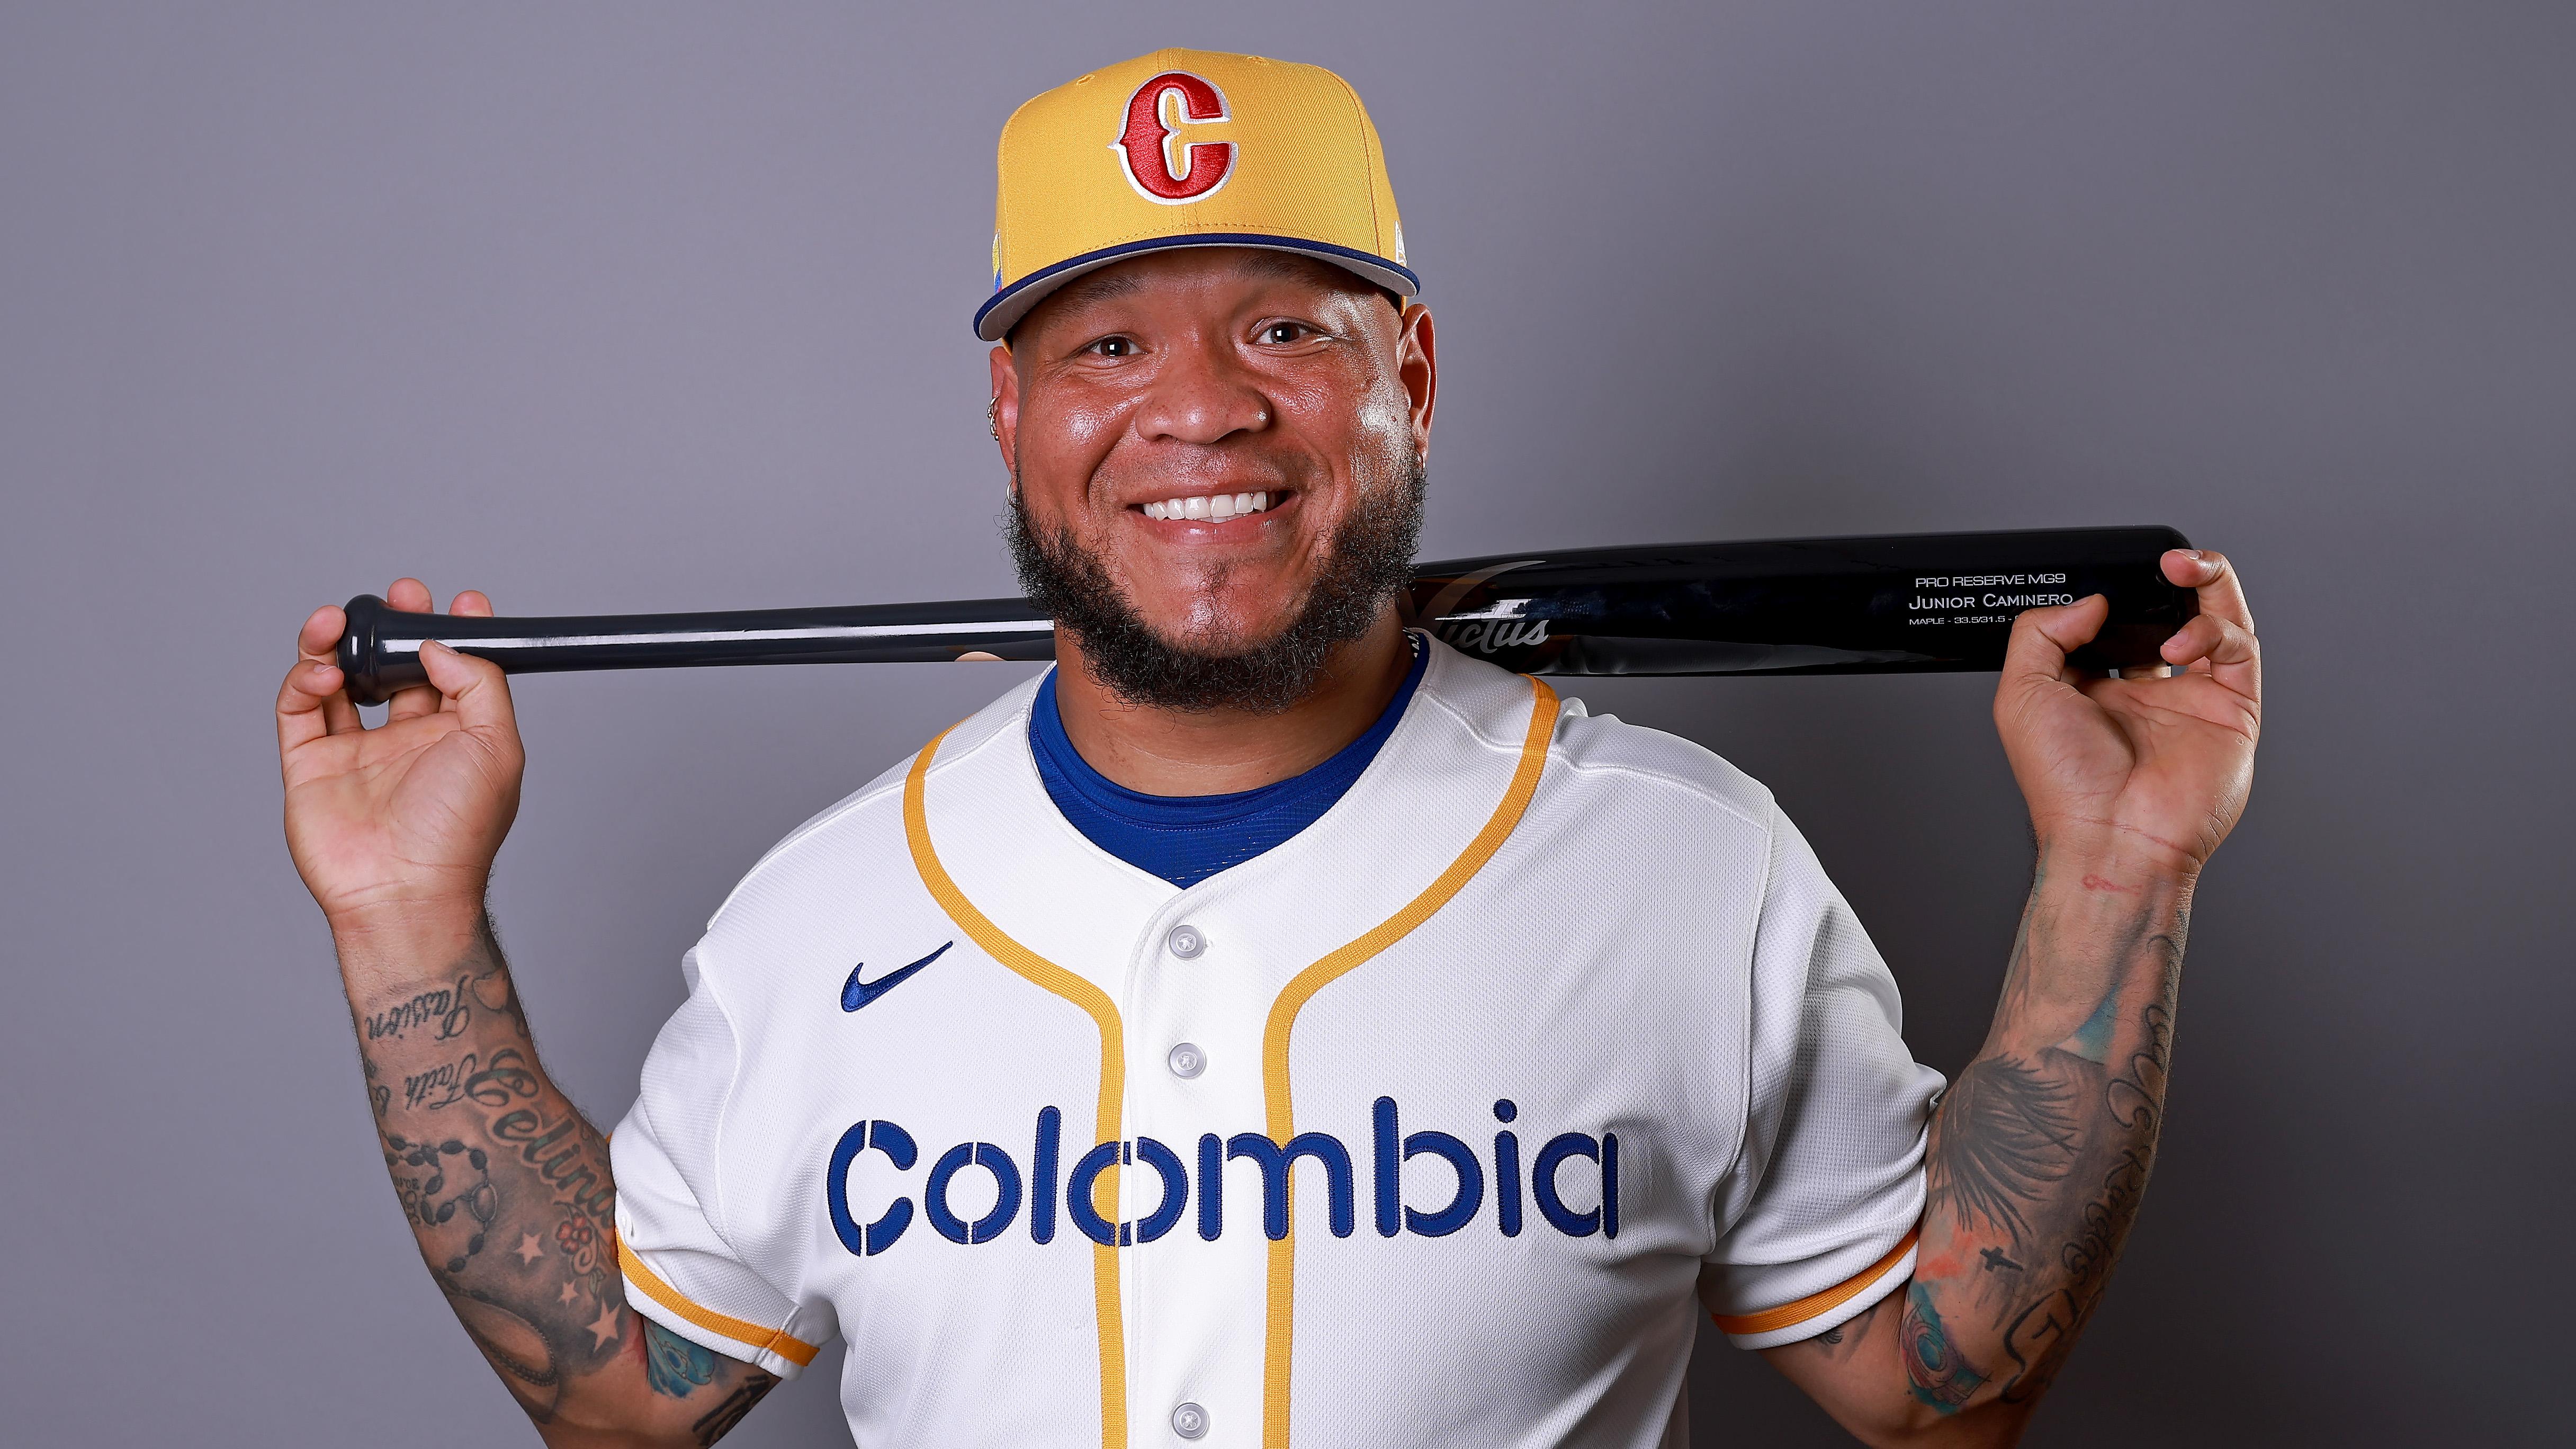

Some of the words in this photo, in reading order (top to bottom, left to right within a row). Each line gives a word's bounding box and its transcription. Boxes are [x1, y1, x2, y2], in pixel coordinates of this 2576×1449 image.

[1107, 70, 1238, 205] C
[1915, 577, 1949, 588] PRO
[1952, 575, 2025, 587] RESERVE
[2028, 573, 2066, 584] MG9
[1954, 615, 2005, 624] 33.5/31.5
[365, 974, 470, 1040] Passion
[405, 1053, 476, 1110] Faith
[827, 1096, 1618, 1257] Colombia
